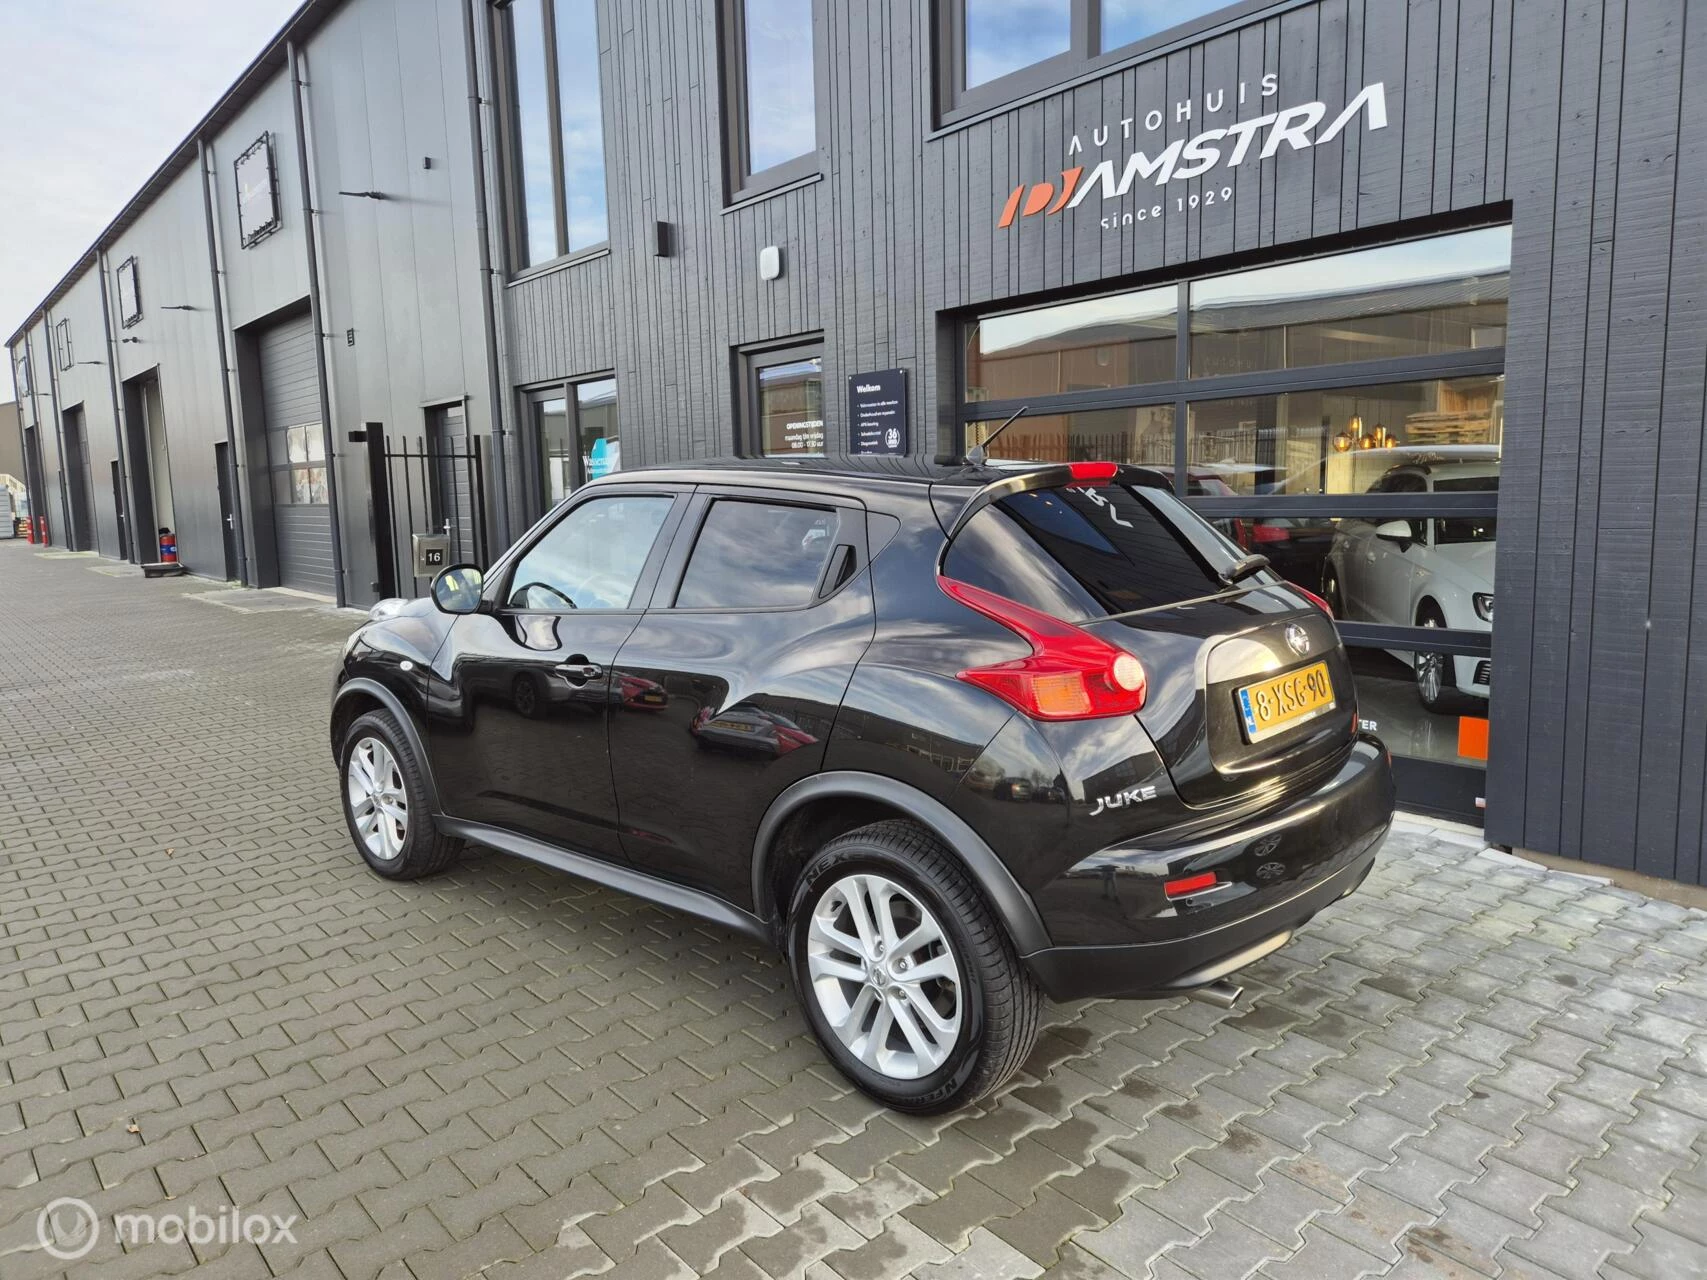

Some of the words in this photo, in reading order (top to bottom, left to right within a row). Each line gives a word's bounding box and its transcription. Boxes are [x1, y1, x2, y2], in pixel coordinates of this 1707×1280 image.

[1068, 73, 1278, 157] AUTOHUIS
[997, 81, 1388, 228] DAMSTRA
[1100, 205, 1162, 230] since
[1177, 187, 1233, 213] 1929
[856, 384, 881, 394] Welkom
[428, 552, 441, 562] 16
[1089, 785, 1157, 816] JUKE
